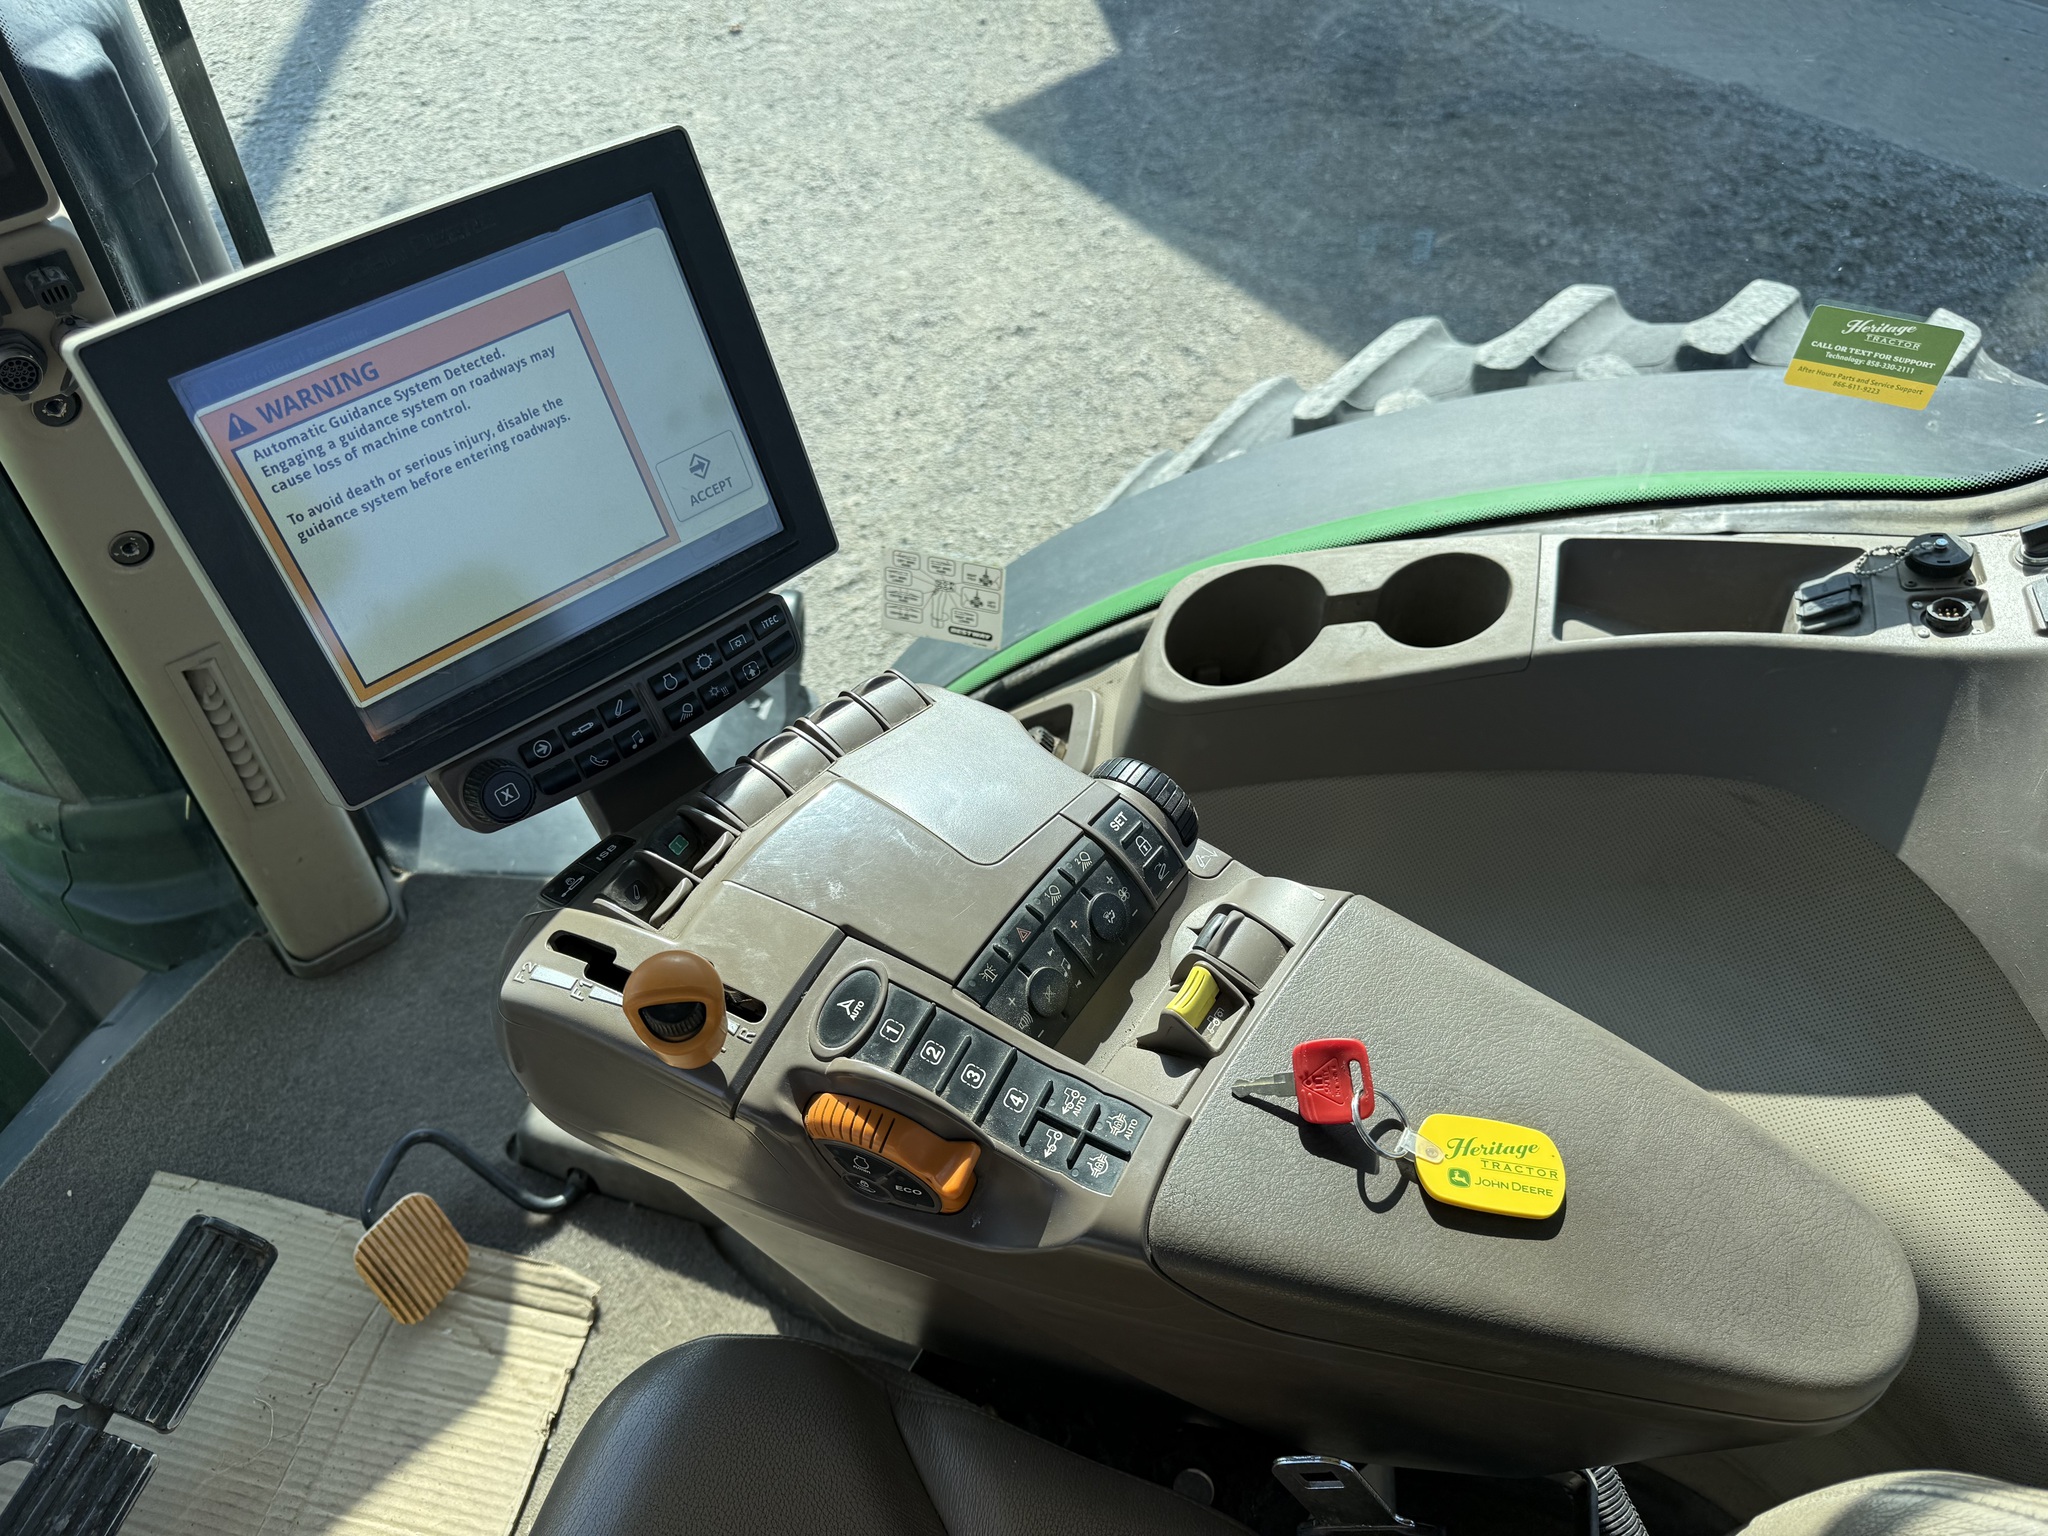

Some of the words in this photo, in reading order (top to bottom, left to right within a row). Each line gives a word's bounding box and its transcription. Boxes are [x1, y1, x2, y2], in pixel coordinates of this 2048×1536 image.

[1841, 319, 1917, 336] Heritage
[1865, 333, 1921, 351] TRACTOR
[1811, 340, 1833, 351] CALL
[1834, 344, 1848, 353] OR
[1849, 347, 1873, 358] TEXT
[1873, 352, 1892, 361] FOR
[1892, 355, 1936, 369] SUPPORT
[1825, 351, 1865, 366] Technology:
[1866, 359, 1915, 374] 858-330-2111
[1797, 365, 1815, 375] After
[1816, 369, 1836, 379] Hours
[1837, 373, 1856, 383] Parts
[1856, 376, 1870, 385] and
[1870, 379, 1894, 391] Service
[1894, 384, 1924, 396] Support
[255, 361, 380, 424] WARNING
[253, 423, 327, 462] Automatic
[328, 396, 393, 429] Guidance
[393, 375, 442, 402] System
[443, 347, 506, 381] Detected.
[261, 444, 327, 478] Engaging
[327, 440, 337, 450] a
[338, 413, 399, 448] guidance
[401, 392, 448, 418] system
[450, 384, 467, 398] on
[469, 357, 528, 389] roadways
[530, 345, 556, 364] may
[271, 470, 313, 494] cause
[313, 456, 342, 475] loss
[344, 446, 359, 462] of
[362, 424, 418, 455] machine
[420, 399, 471, 429] control.
[286, 512, 305, 526] To
[307, 492, 344, 518] avoid
[346, 475, 386, 500] death
[388, 468, 402, 481] or
[404, 446, 453, 474] serious
[453, 428, 496, 452] injury,
[496, 408, 541, 433] disable
[542, 398, 564, 413] the
[297, 508, 359, 545] guidance
[361, 485, 408, 513] system
[410, 464, 453, 490] before
[455, 439, 510, 470] entering
[510, 413, 571, 446] roadways.
[690, 476, 733, 507] ACCEPT
[761, 614, 779, 629] iTEC
[1109, 811, 1128, 832] SET
[513, 961, 537, 984] F2
[570, 980, 593, 1001] F1
[849, 1000, 865, 1021] AUTO
[737, 1027, 756, 1044] R
[886, 1025, 900, 1035] 1
[925, 1046, 941, 1060] 2
[966, 1070, 981, 1083] 3
[1010, 1093, 1024, 1107] 4
[1072, 1095, 1087, 1117] AUTO
[1123, 1119, 1138, 1141] AUTO
[1444, 1137, 1540, 1160] Heritage
[1481, 1159, 1558, 1179] TRACTOR
[895, 1184, 922, 1196] ECO
[1475, 1176, 1510, 1190] JOHN
[1511, 1181, 1554, 1197] DEERE
